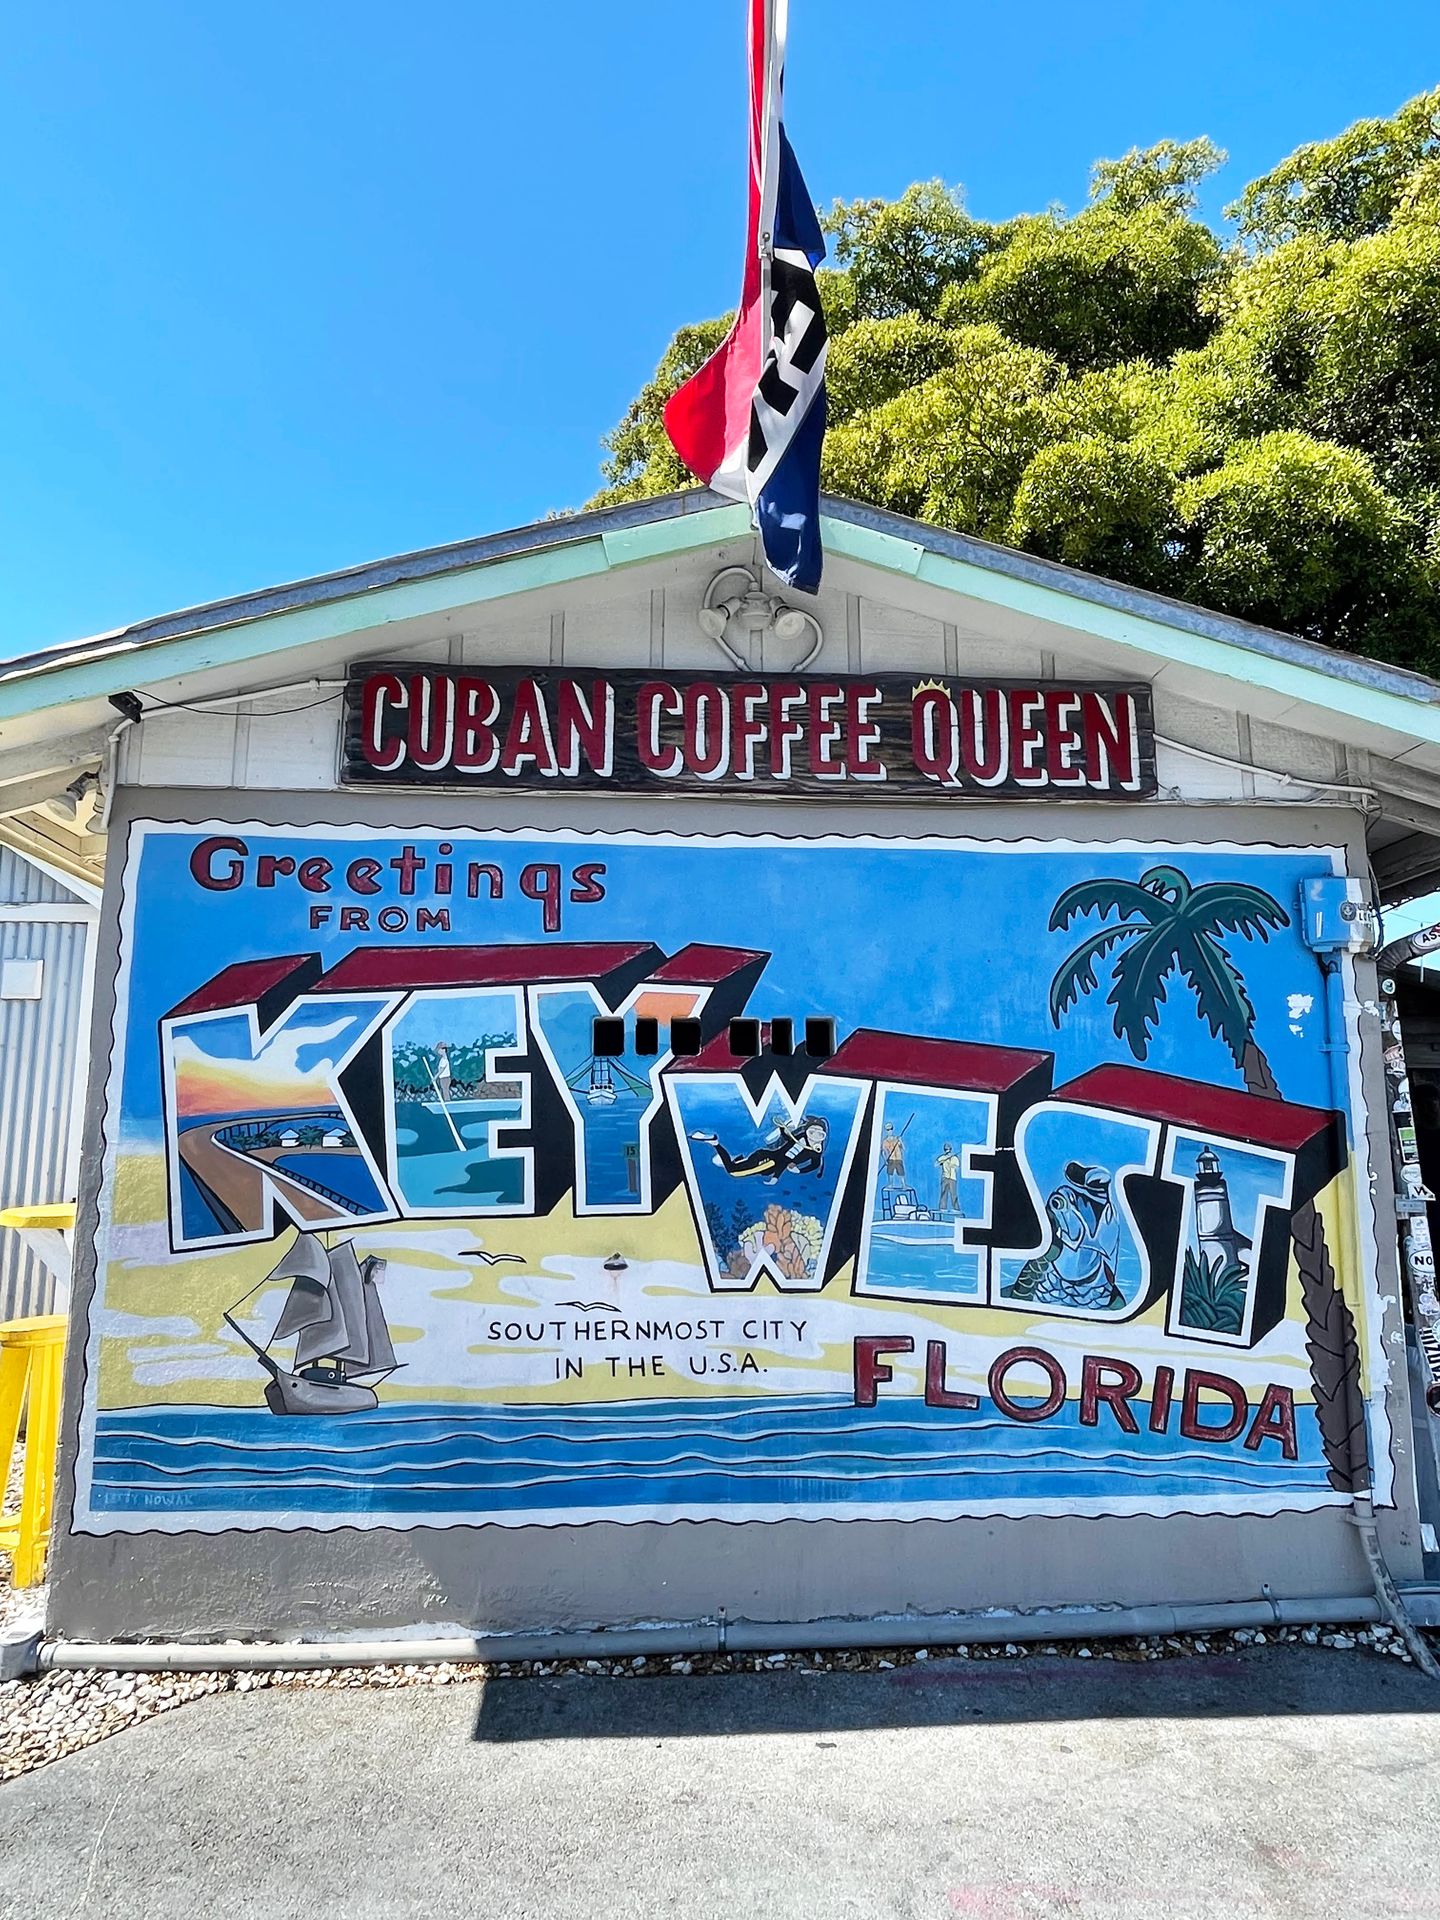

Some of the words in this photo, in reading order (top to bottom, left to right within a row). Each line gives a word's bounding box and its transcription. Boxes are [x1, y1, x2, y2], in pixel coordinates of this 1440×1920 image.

[361, 673, 614, 778] CUBAN
[636, 680, 887, 782] COFFEE
[911, 686, 1142, 791] QUEEN
[309, 905, 452, 932] FROM
[160, 972, 724, 1254] KEY
[658, 1060, 1308, 1350] WEST
[487, 1319, 725, 1342] SOUTHERNMOST
[742, 1319, 808, 1342] CITY
[554, 1356, 584, 1380] IN
[604, 1355, 666, 1378] THE
[689, 1352, 768, 1376] U.S.A.
[853, 1335, 1299, 1462] FLORIDA
